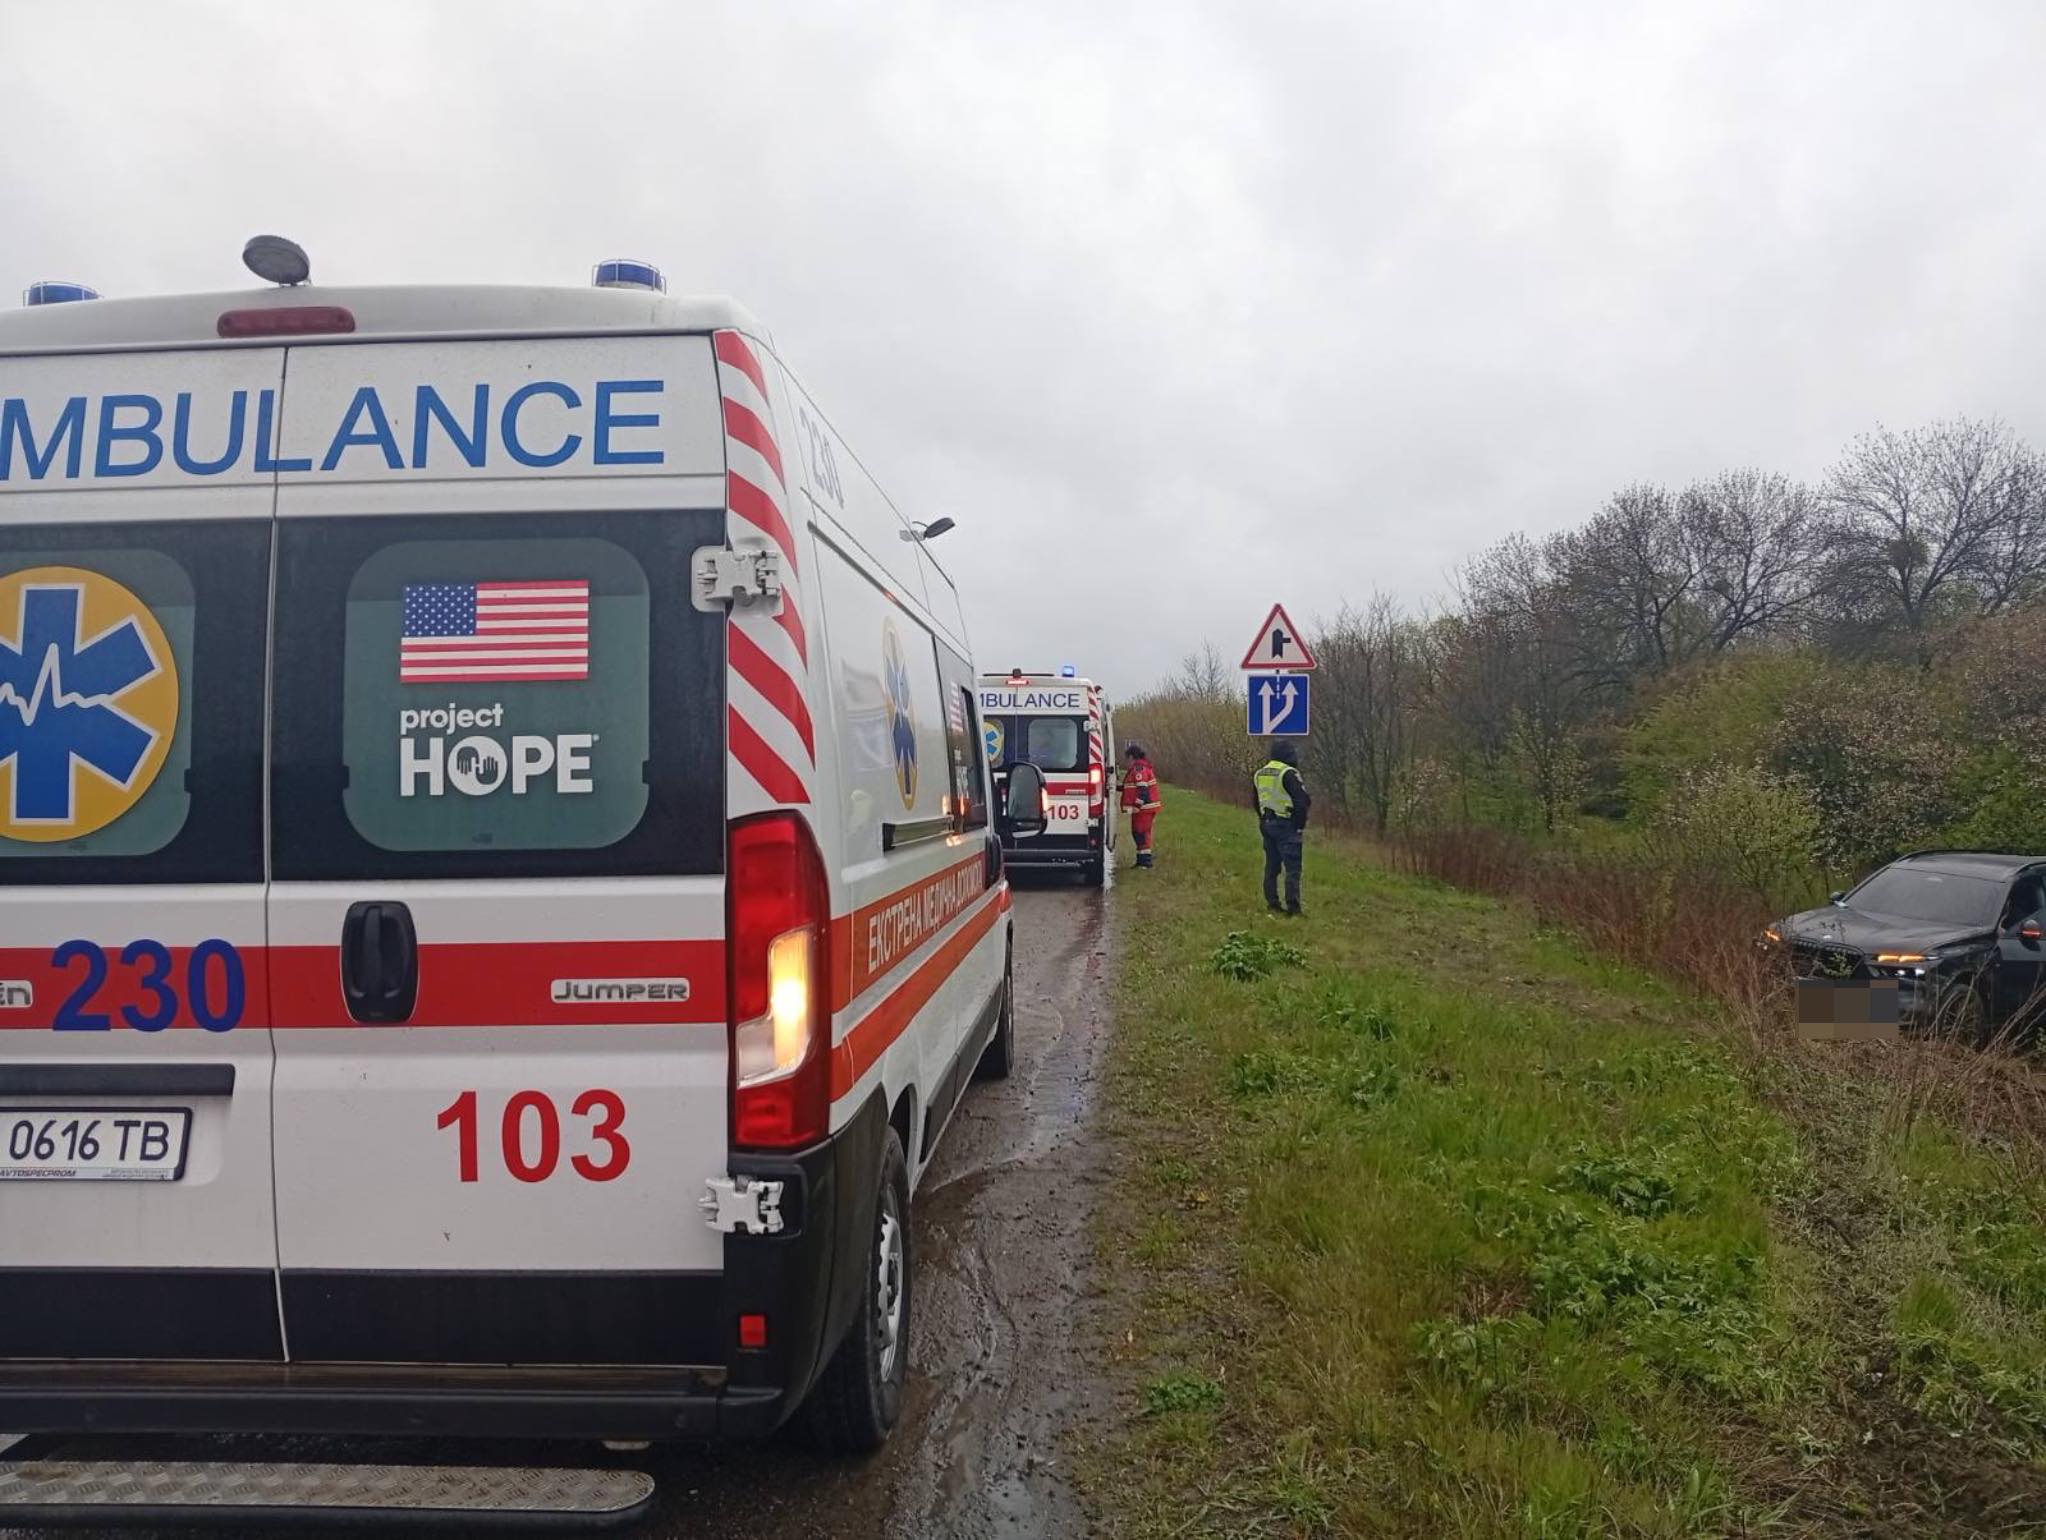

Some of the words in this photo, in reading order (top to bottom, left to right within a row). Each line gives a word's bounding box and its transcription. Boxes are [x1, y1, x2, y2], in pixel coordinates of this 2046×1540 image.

[400, 702, 504, 735] project
[400, 734, 593, 796] HOPE
[1048, 804, 1079, 820] 103
[868, 892, 922, 975] ЕКСТРЕНА
[51, 939, 245, 1033] 230
[9, 1119, 101, 1161] 0616
[113, 1119, 170, 1161] TB
[437, 1089, 631, 1182] 103
